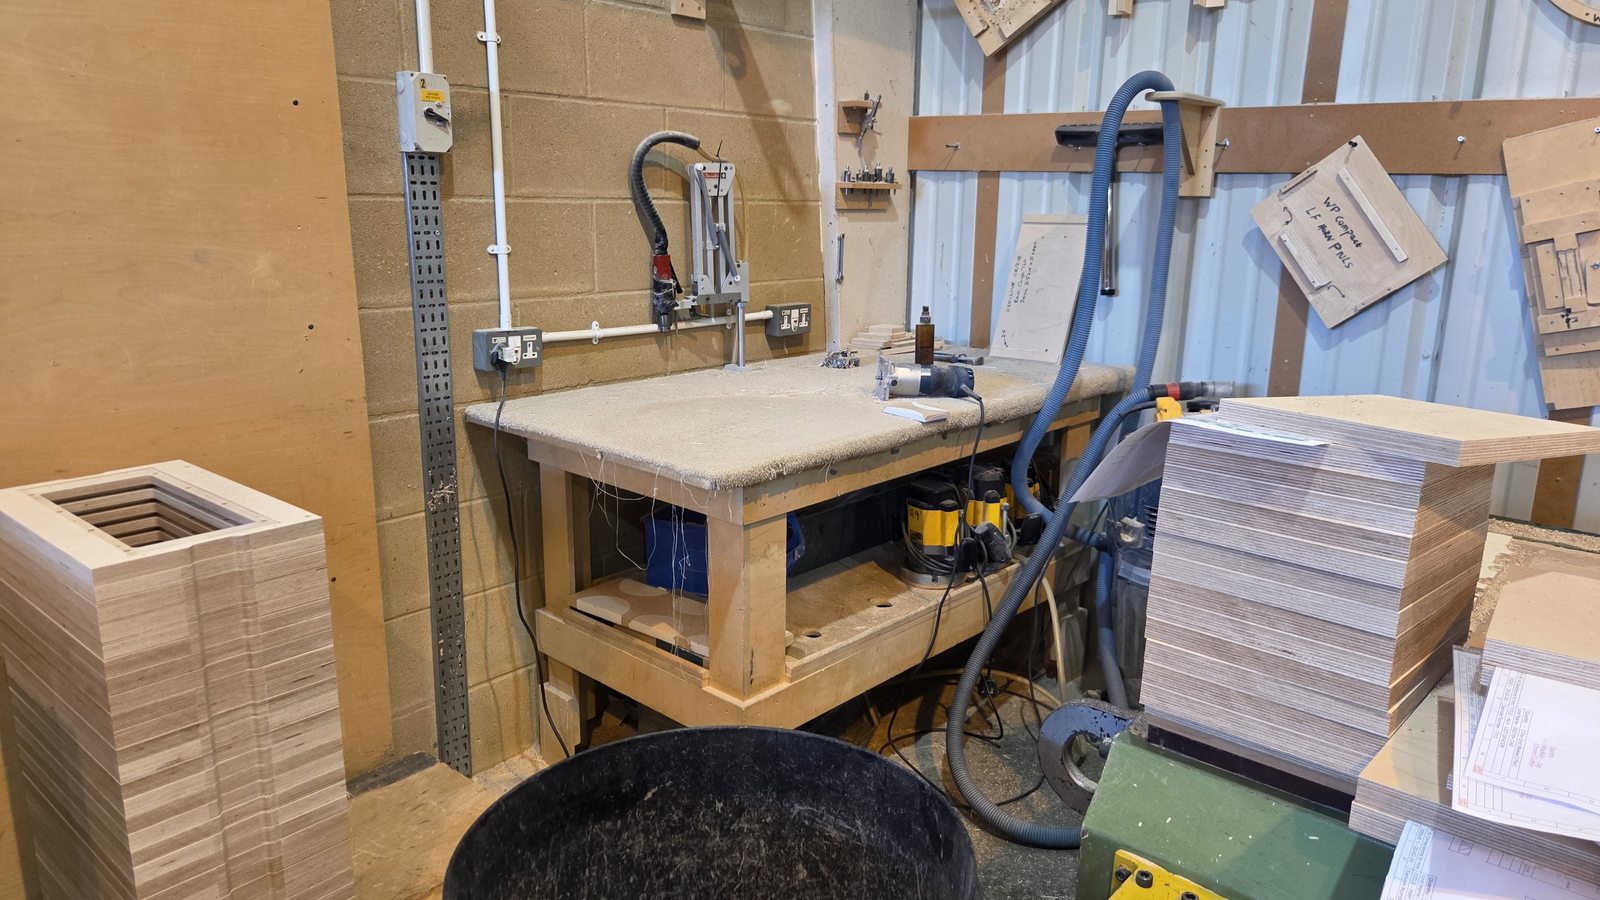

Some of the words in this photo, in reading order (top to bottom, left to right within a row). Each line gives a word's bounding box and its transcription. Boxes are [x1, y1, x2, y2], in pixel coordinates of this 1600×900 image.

[420, 78, 426, 88] 2
[1323, 196, 1341, 212] WP
[1335, 216, 1363, 248] Compact
